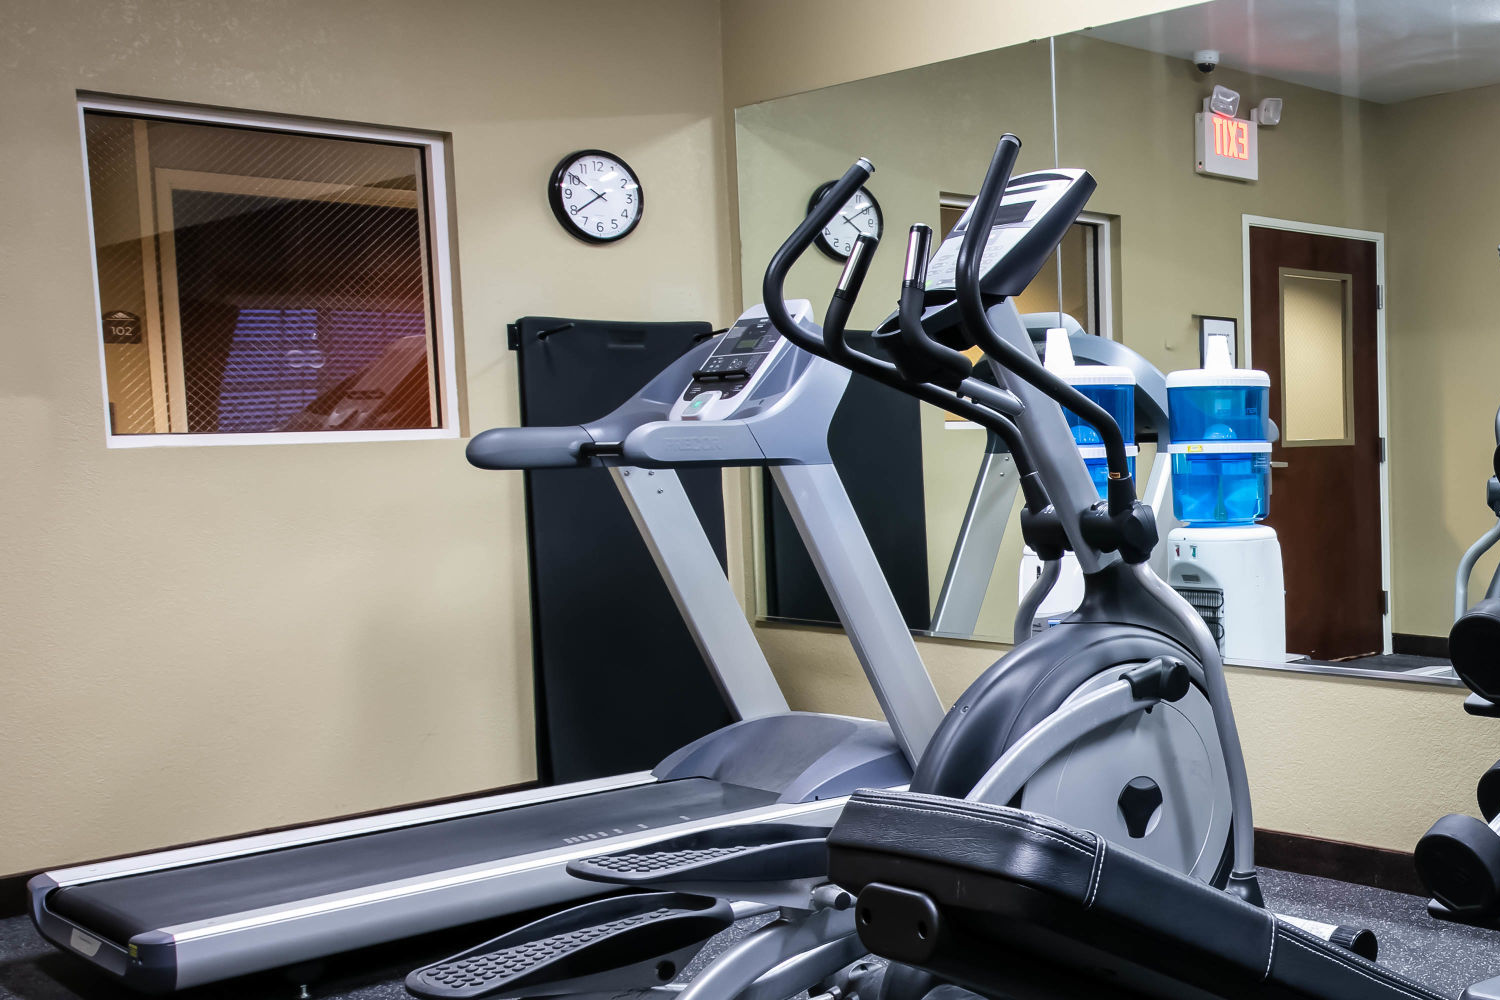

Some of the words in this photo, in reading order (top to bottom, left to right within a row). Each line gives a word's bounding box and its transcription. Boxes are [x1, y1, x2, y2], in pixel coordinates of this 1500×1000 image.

[579, 163, 587, 174] 11
[592, 160, 604, 172] 12
[568, 174, 580, 185] 10
[620, 178, 628, 189] 2
[564, 188, 573, 199] 9
[626, 193, 633, 204] 3
[570, 204, 578, 216] 8
[620, 208, 629, 218] 4
[581, 216, 589, 226] 7
[596, 221, 604, 232] 6
[611, 218, 619, 229] 5
[111, 326, 133, 336] 102
